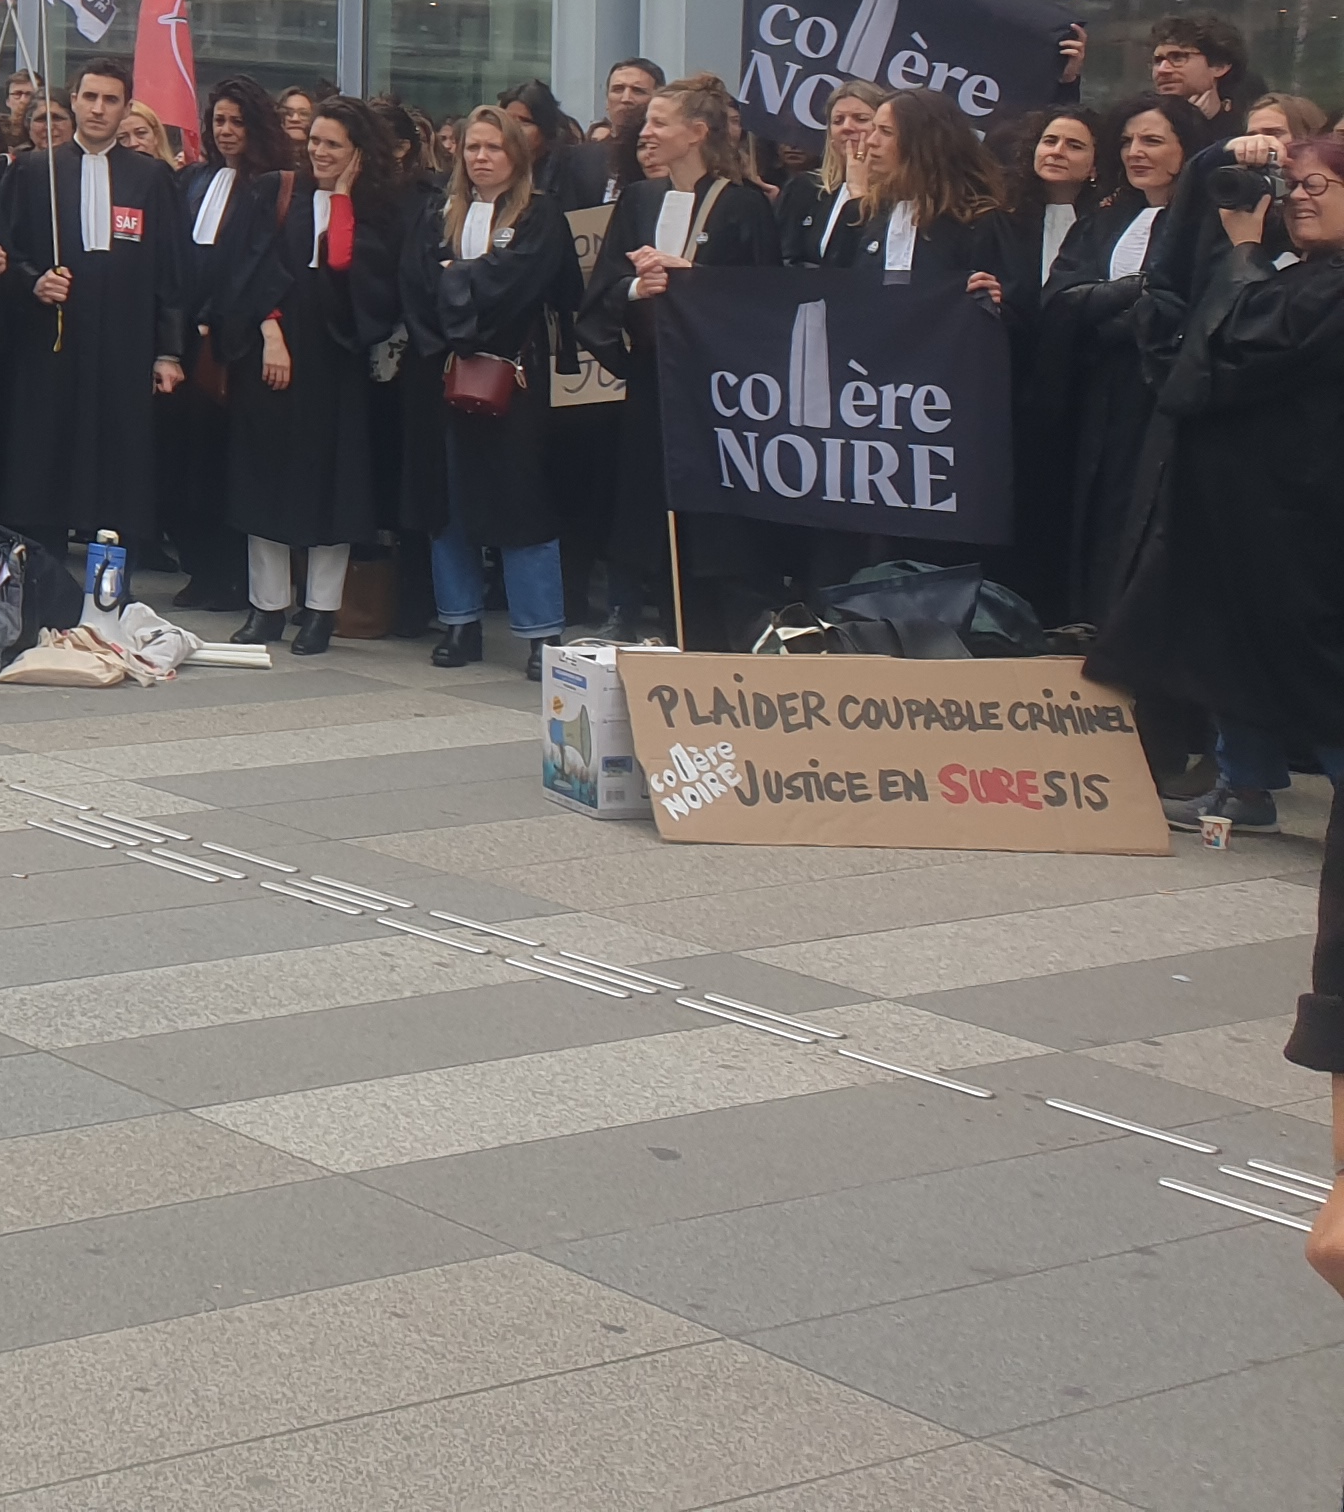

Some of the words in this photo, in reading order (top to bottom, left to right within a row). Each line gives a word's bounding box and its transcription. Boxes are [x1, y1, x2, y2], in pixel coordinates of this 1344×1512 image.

[115, 214, 138, 230] SAF
[713, 427, 957, 513] NOIRE
[838, 694, 1004, 733] COUPABLE
[661, 761, 743, 822] NOIRE
[879, 768, 929, 802] EN
